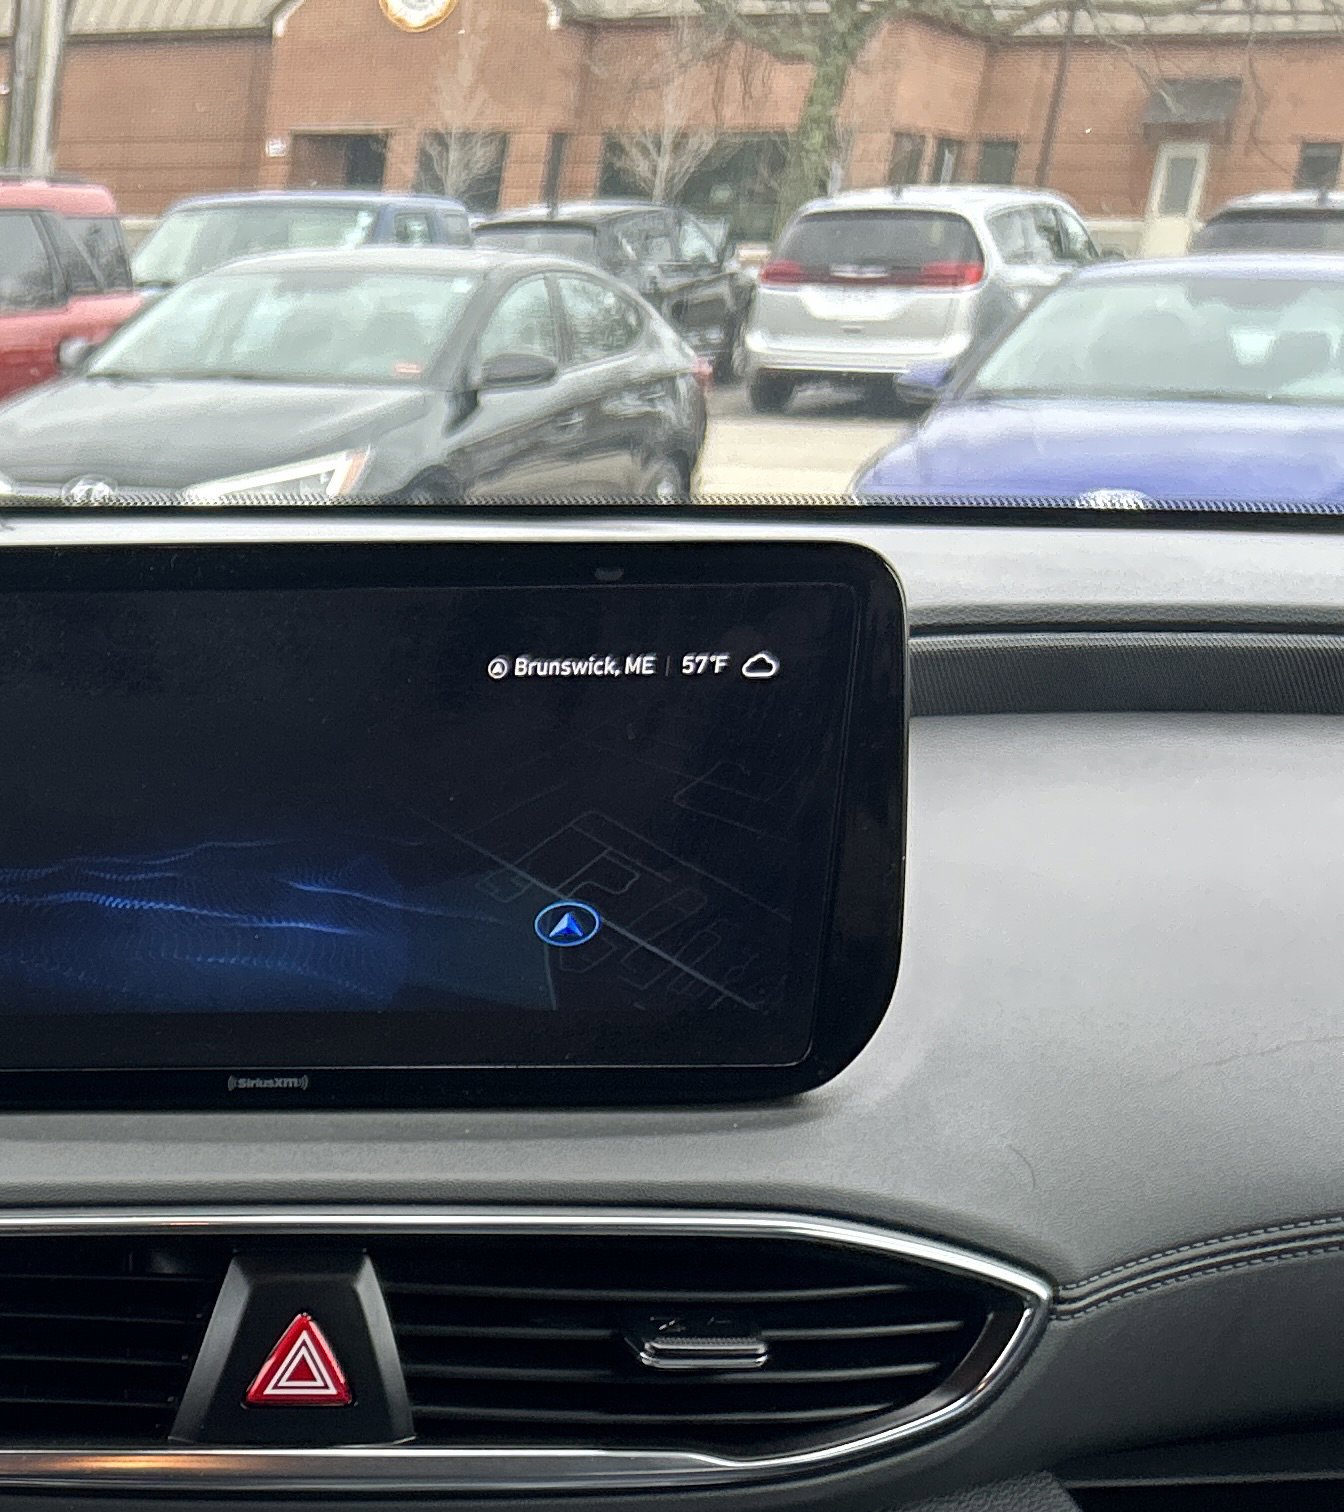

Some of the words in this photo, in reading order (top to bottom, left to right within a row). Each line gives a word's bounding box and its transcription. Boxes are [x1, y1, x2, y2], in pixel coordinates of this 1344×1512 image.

[514, 655, 620, 677] Brunswick,
[625, 655, 657, 675] ME
[682, 655, 729, 674] 57°F
